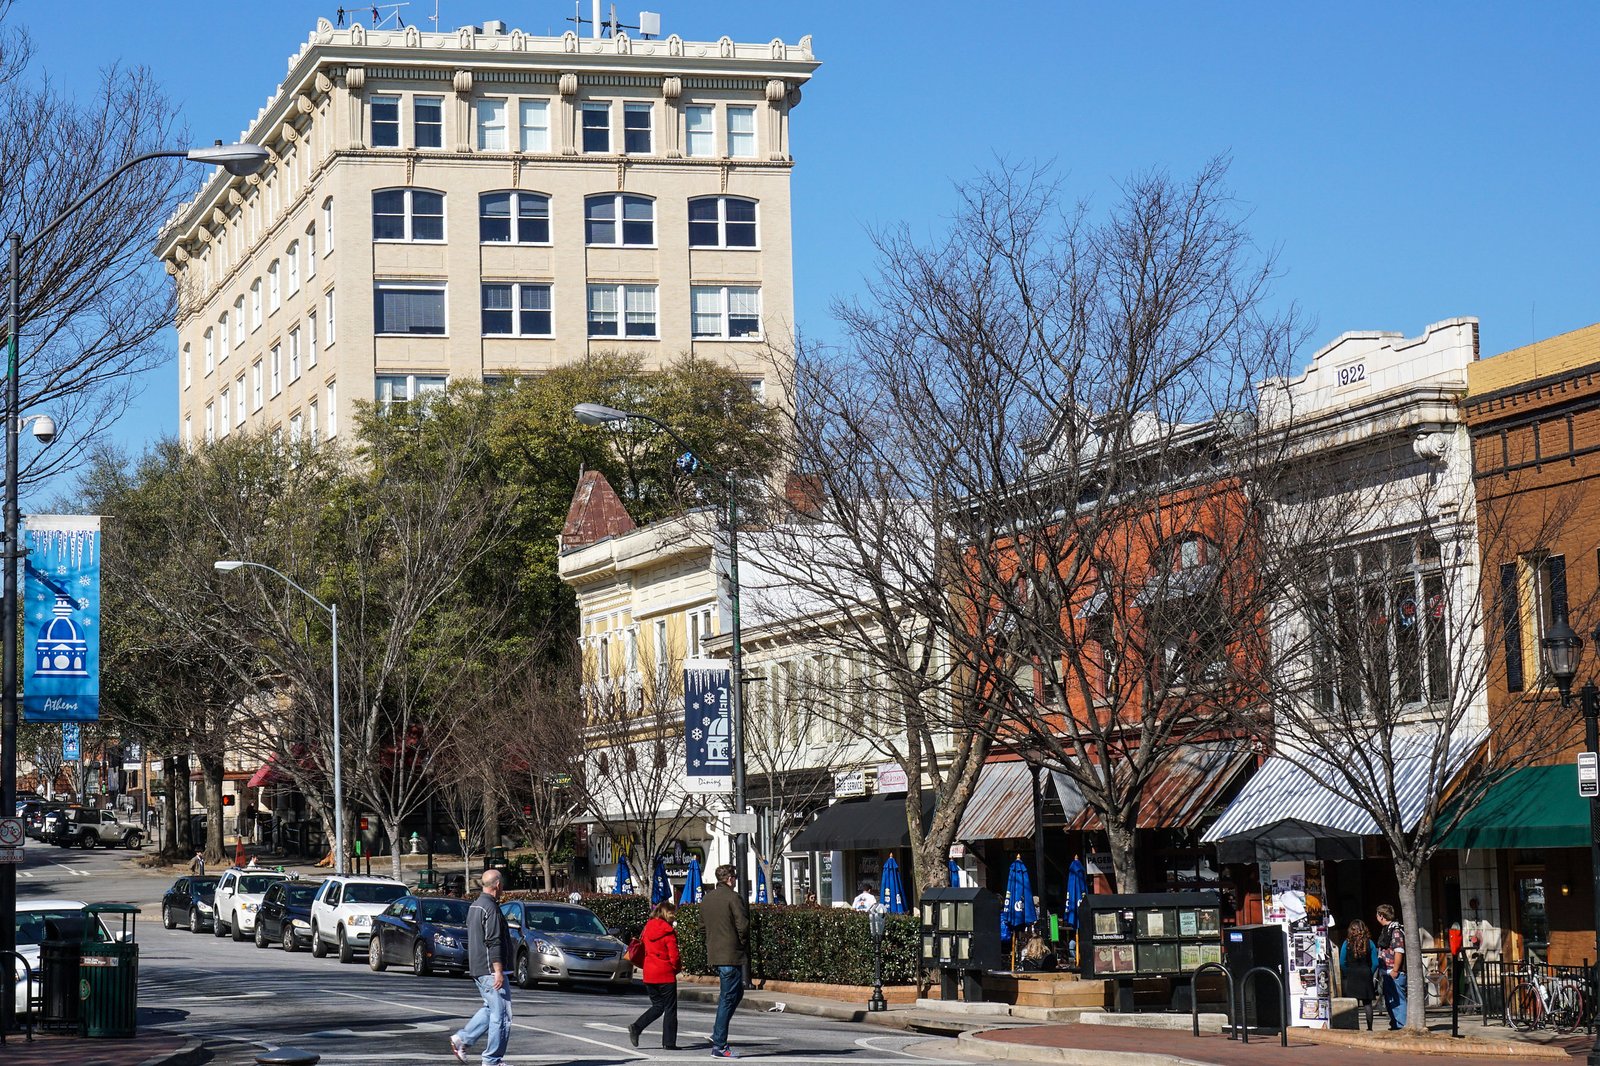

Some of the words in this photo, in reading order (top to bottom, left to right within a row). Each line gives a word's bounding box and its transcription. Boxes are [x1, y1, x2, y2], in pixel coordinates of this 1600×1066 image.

[1337, 364, 1365, 387] 1922
[43, 697, 79, 711] Athens
[698, 777, 722, 788] Dining
[593, 834, 635, 865] SUBWAY
